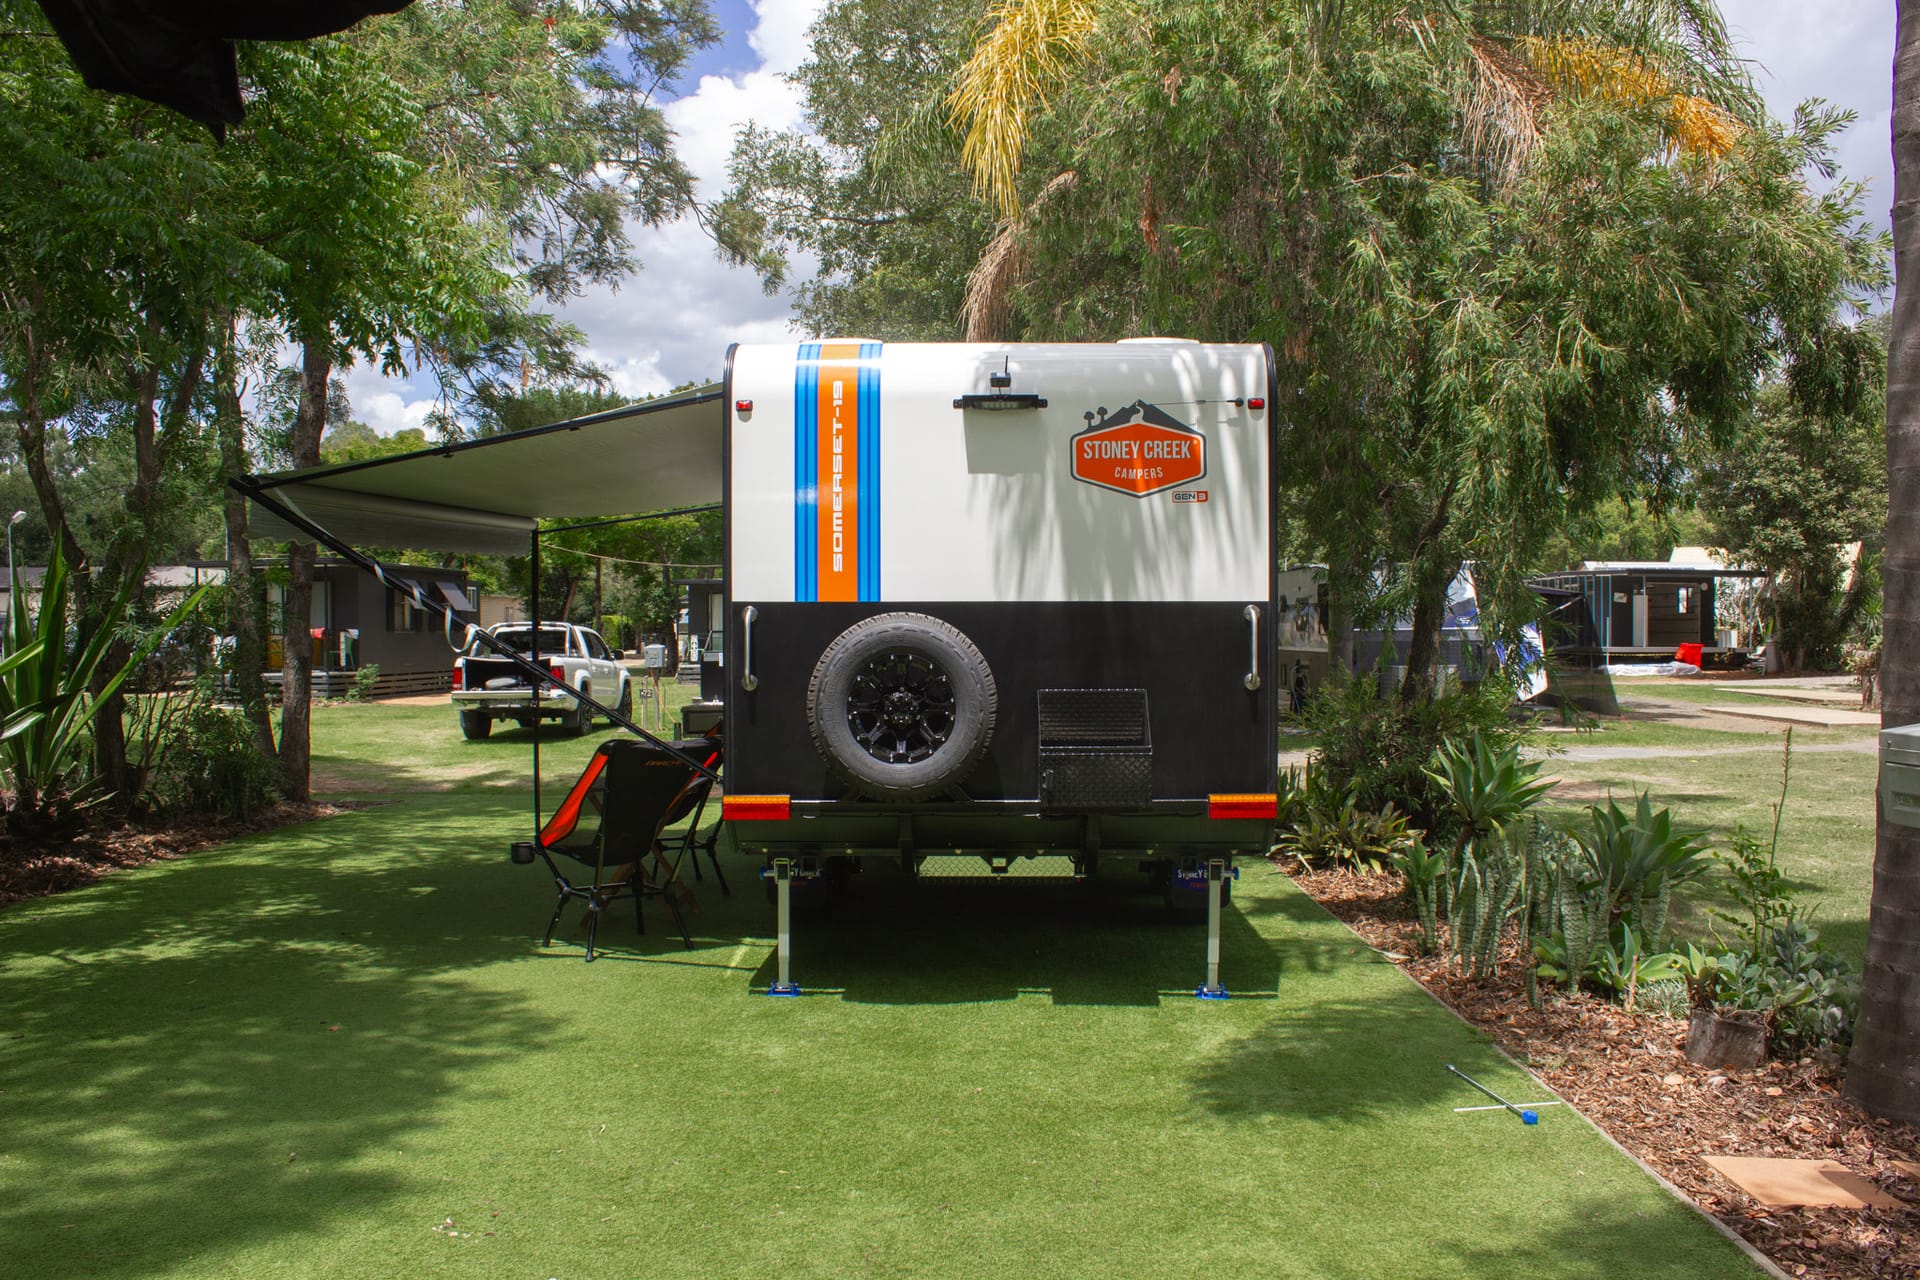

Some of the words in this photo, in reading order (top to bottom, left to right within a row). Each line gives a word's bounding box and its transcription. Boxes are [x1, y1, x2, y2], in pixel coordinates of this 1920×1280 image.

[1083, 440, 1140, 459] STONEY
[1144, 440, 1191, 459] CREEK
[1114, 466, 1164, 480] CAMPERS
[1174, 493, 1196, 501] GEN
